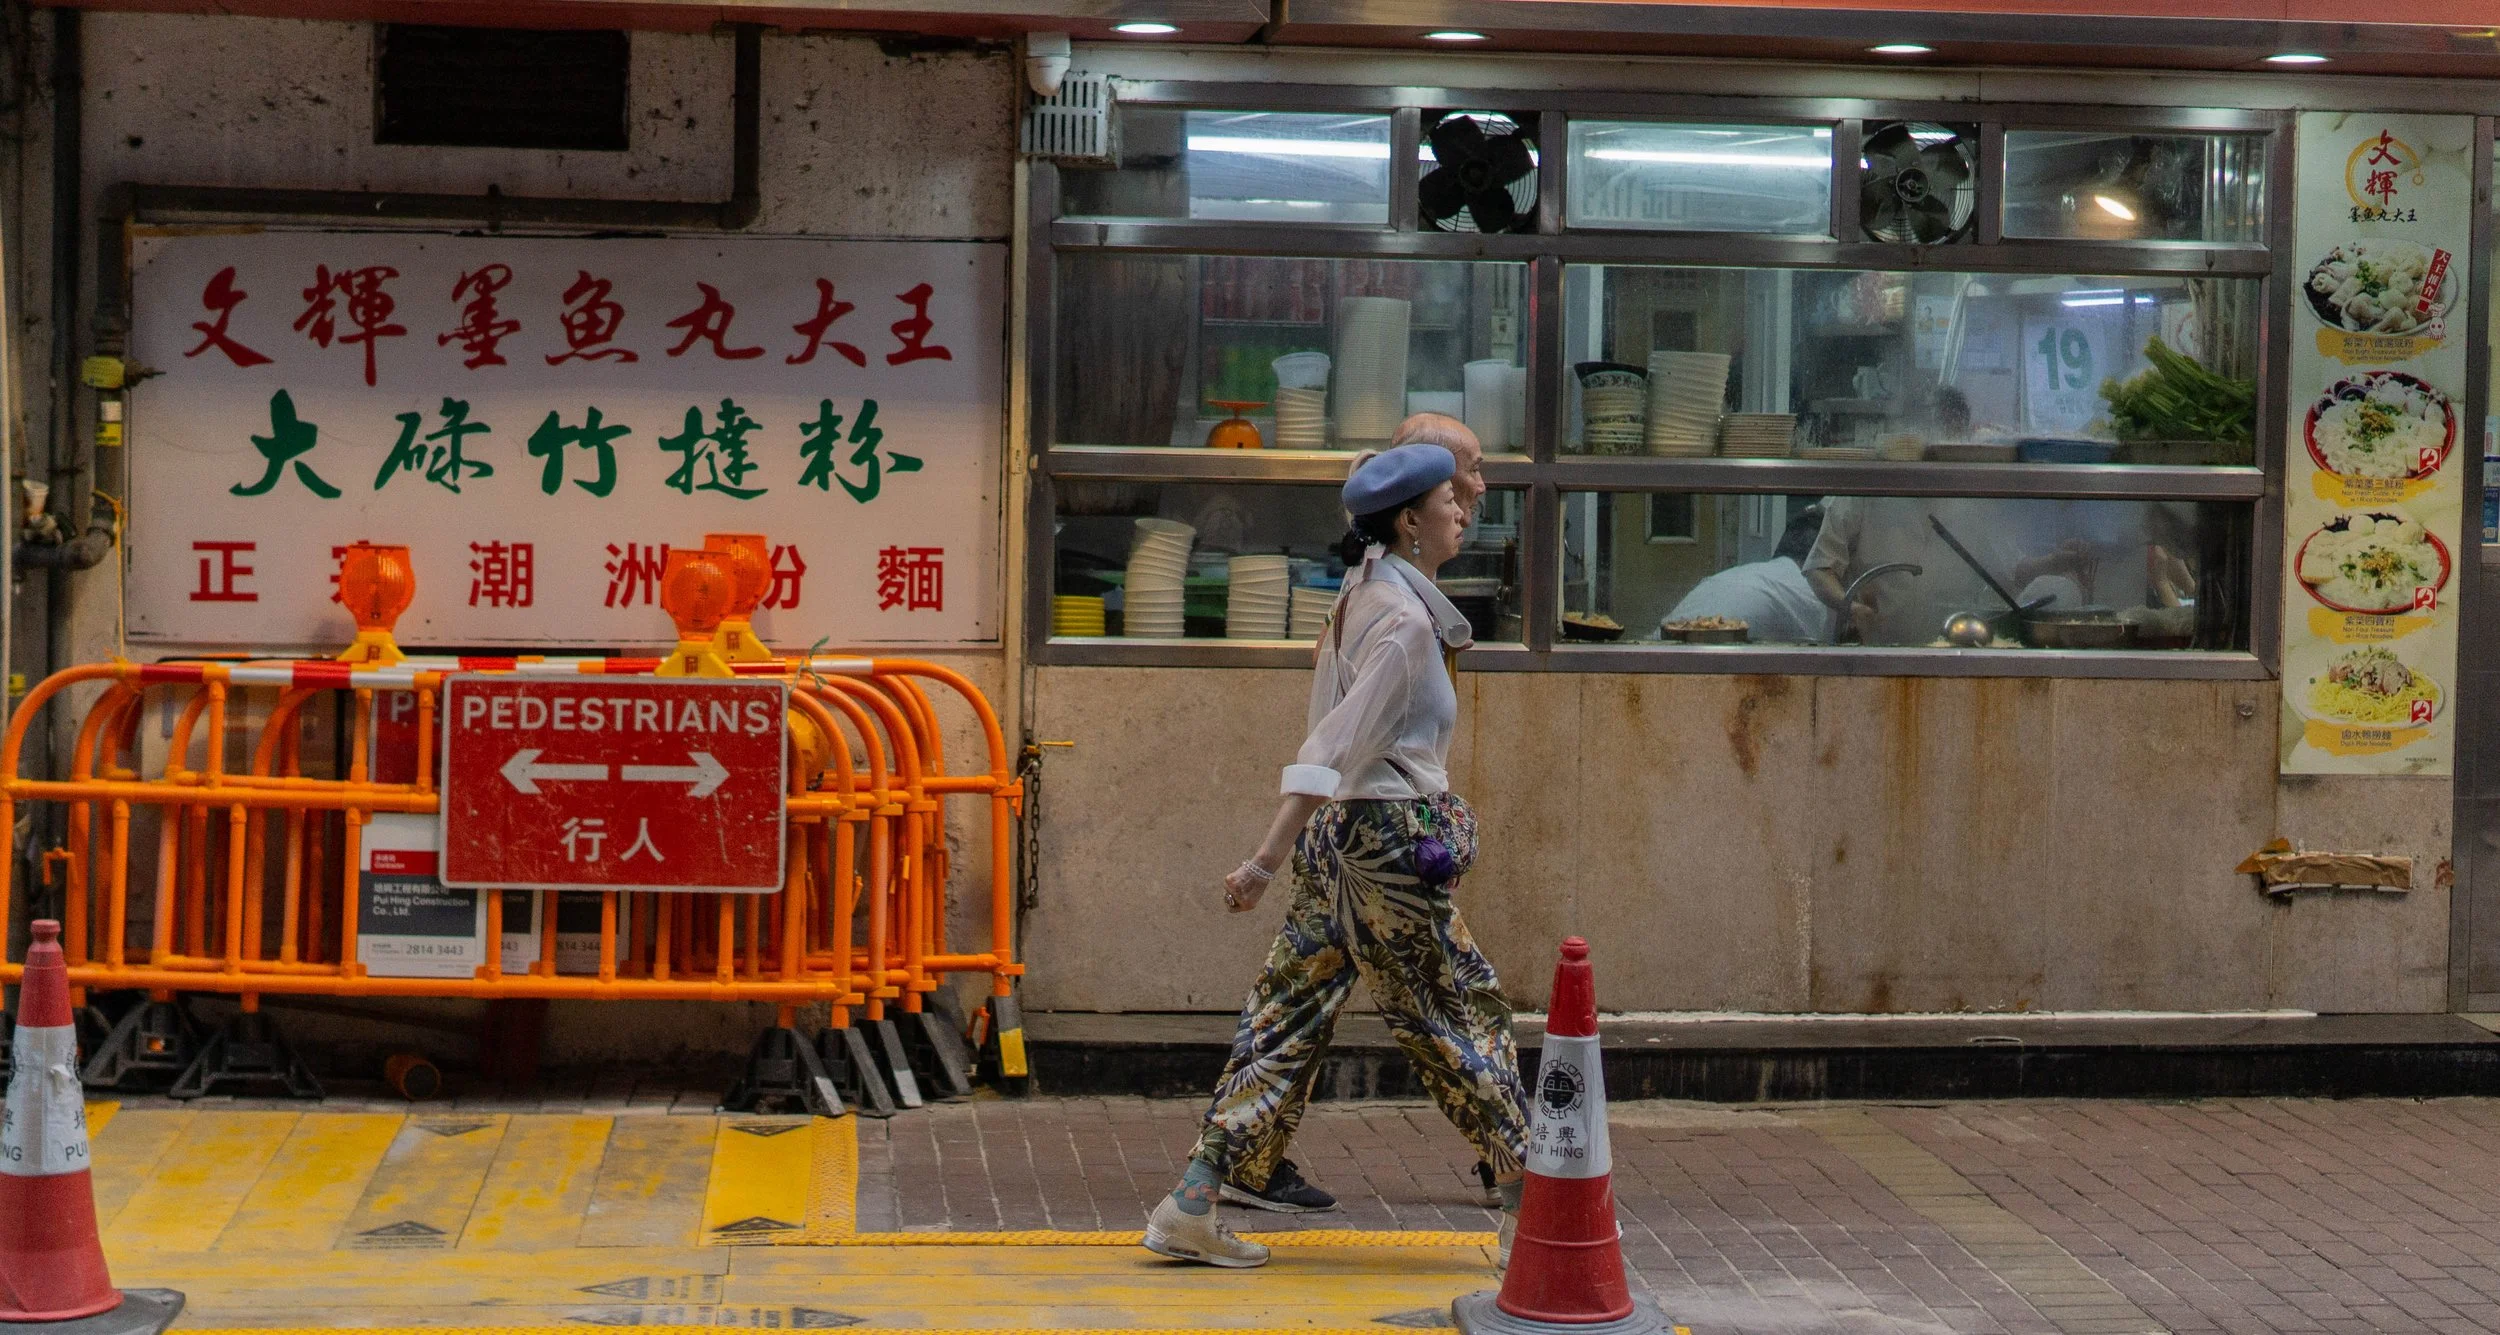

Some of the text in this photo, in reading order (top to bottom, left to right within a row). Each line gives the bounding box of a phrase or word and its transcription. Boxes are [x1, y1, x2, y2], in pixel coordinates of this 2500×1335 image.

[2038, 327, 2093, 391] 19
[463, 696, 770, 734] PEDESTRIANS
[560, 817, 665, 863] 行人
[373, 895, 470, 907] Pui Hing Construction
[406, 944, 433, 955] 2814
[437, 944, 464, 956] 3443
[1535, 1123, 1577, 1144] 培興
[1530, 1142, 1584, 1159] PUI HING
